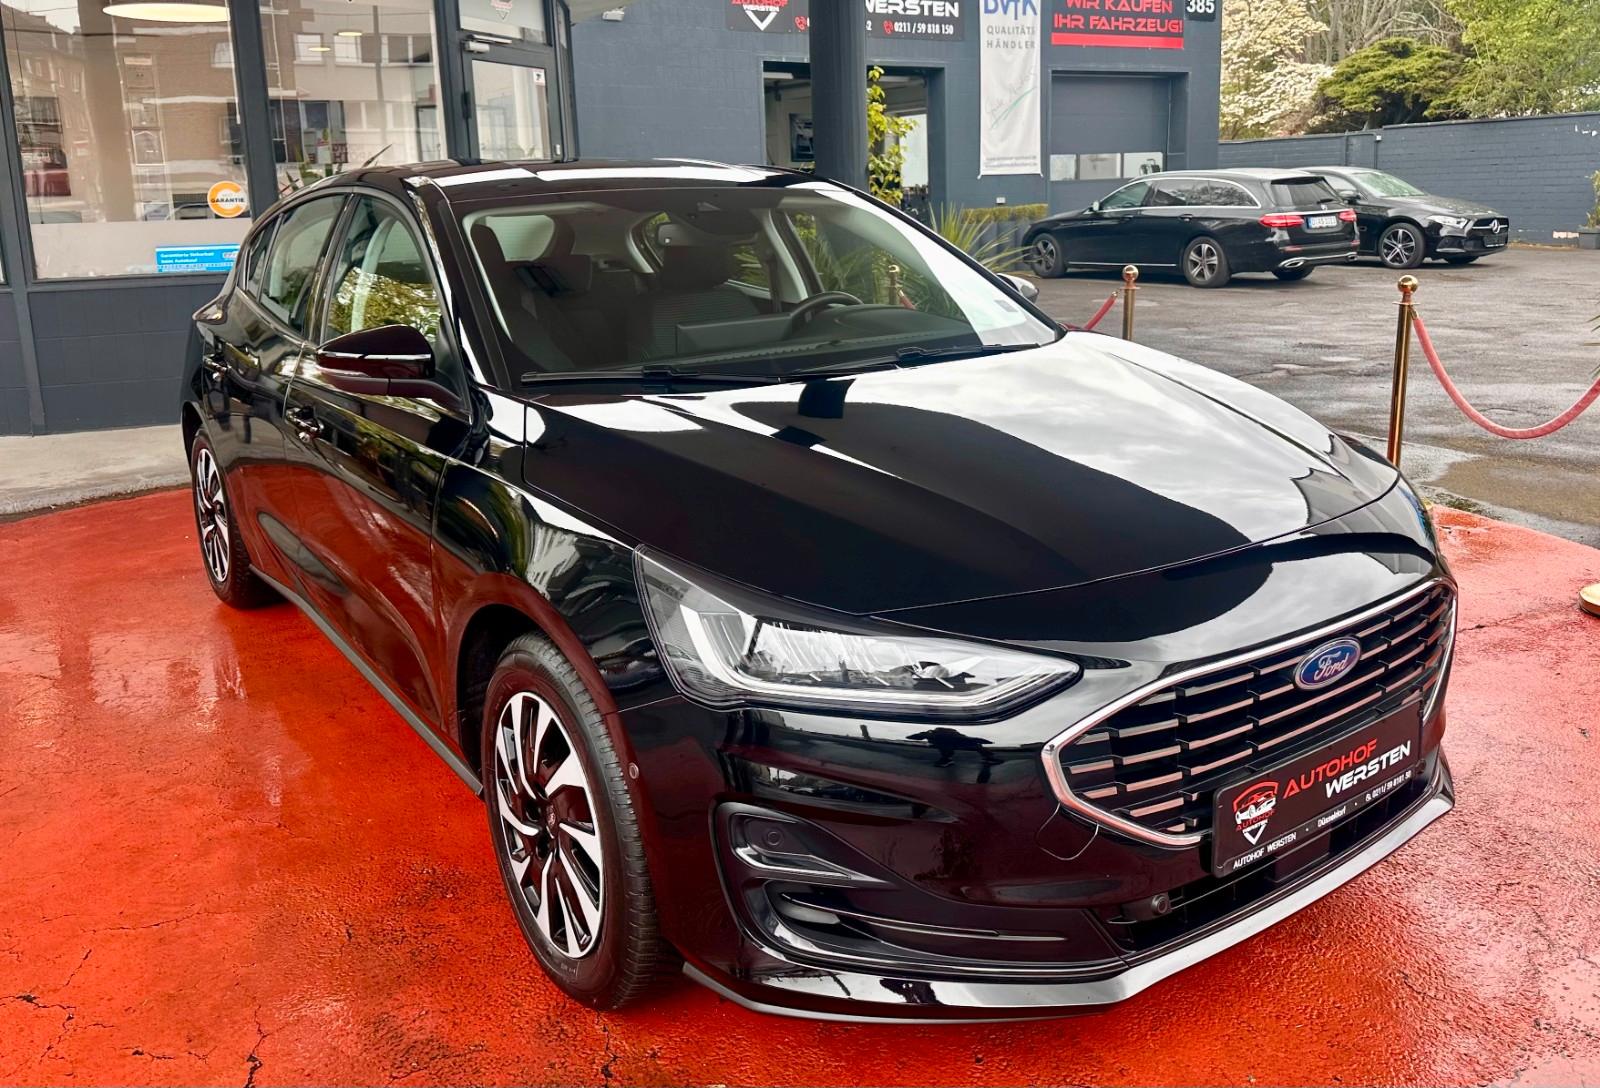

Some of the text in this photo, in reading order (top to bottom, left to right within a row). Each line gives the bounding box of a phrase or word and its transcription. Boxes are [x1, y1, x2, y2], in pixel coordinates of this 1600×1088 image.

[1104, 0, 1173, 13] KAUFEN
[1186, 0, 1215, 13] 385
[894, 21, 911, 33] 0211
[917, 23, 926, 34] 59
[1053, 13, 1183, 33] IHR FAHRZEUG!
[986, 38, 1036, 49] HÄNDLER
[1313, 650, 1350, 681] Ford
[1283, 738, 1378, 799] AUTOHOF
[1325, 740, 1411, 799] WERSTEN
[1232, 847, 1265, 870] AUTOHOF
[1266, 831, 1297, 853] WERSTEN
